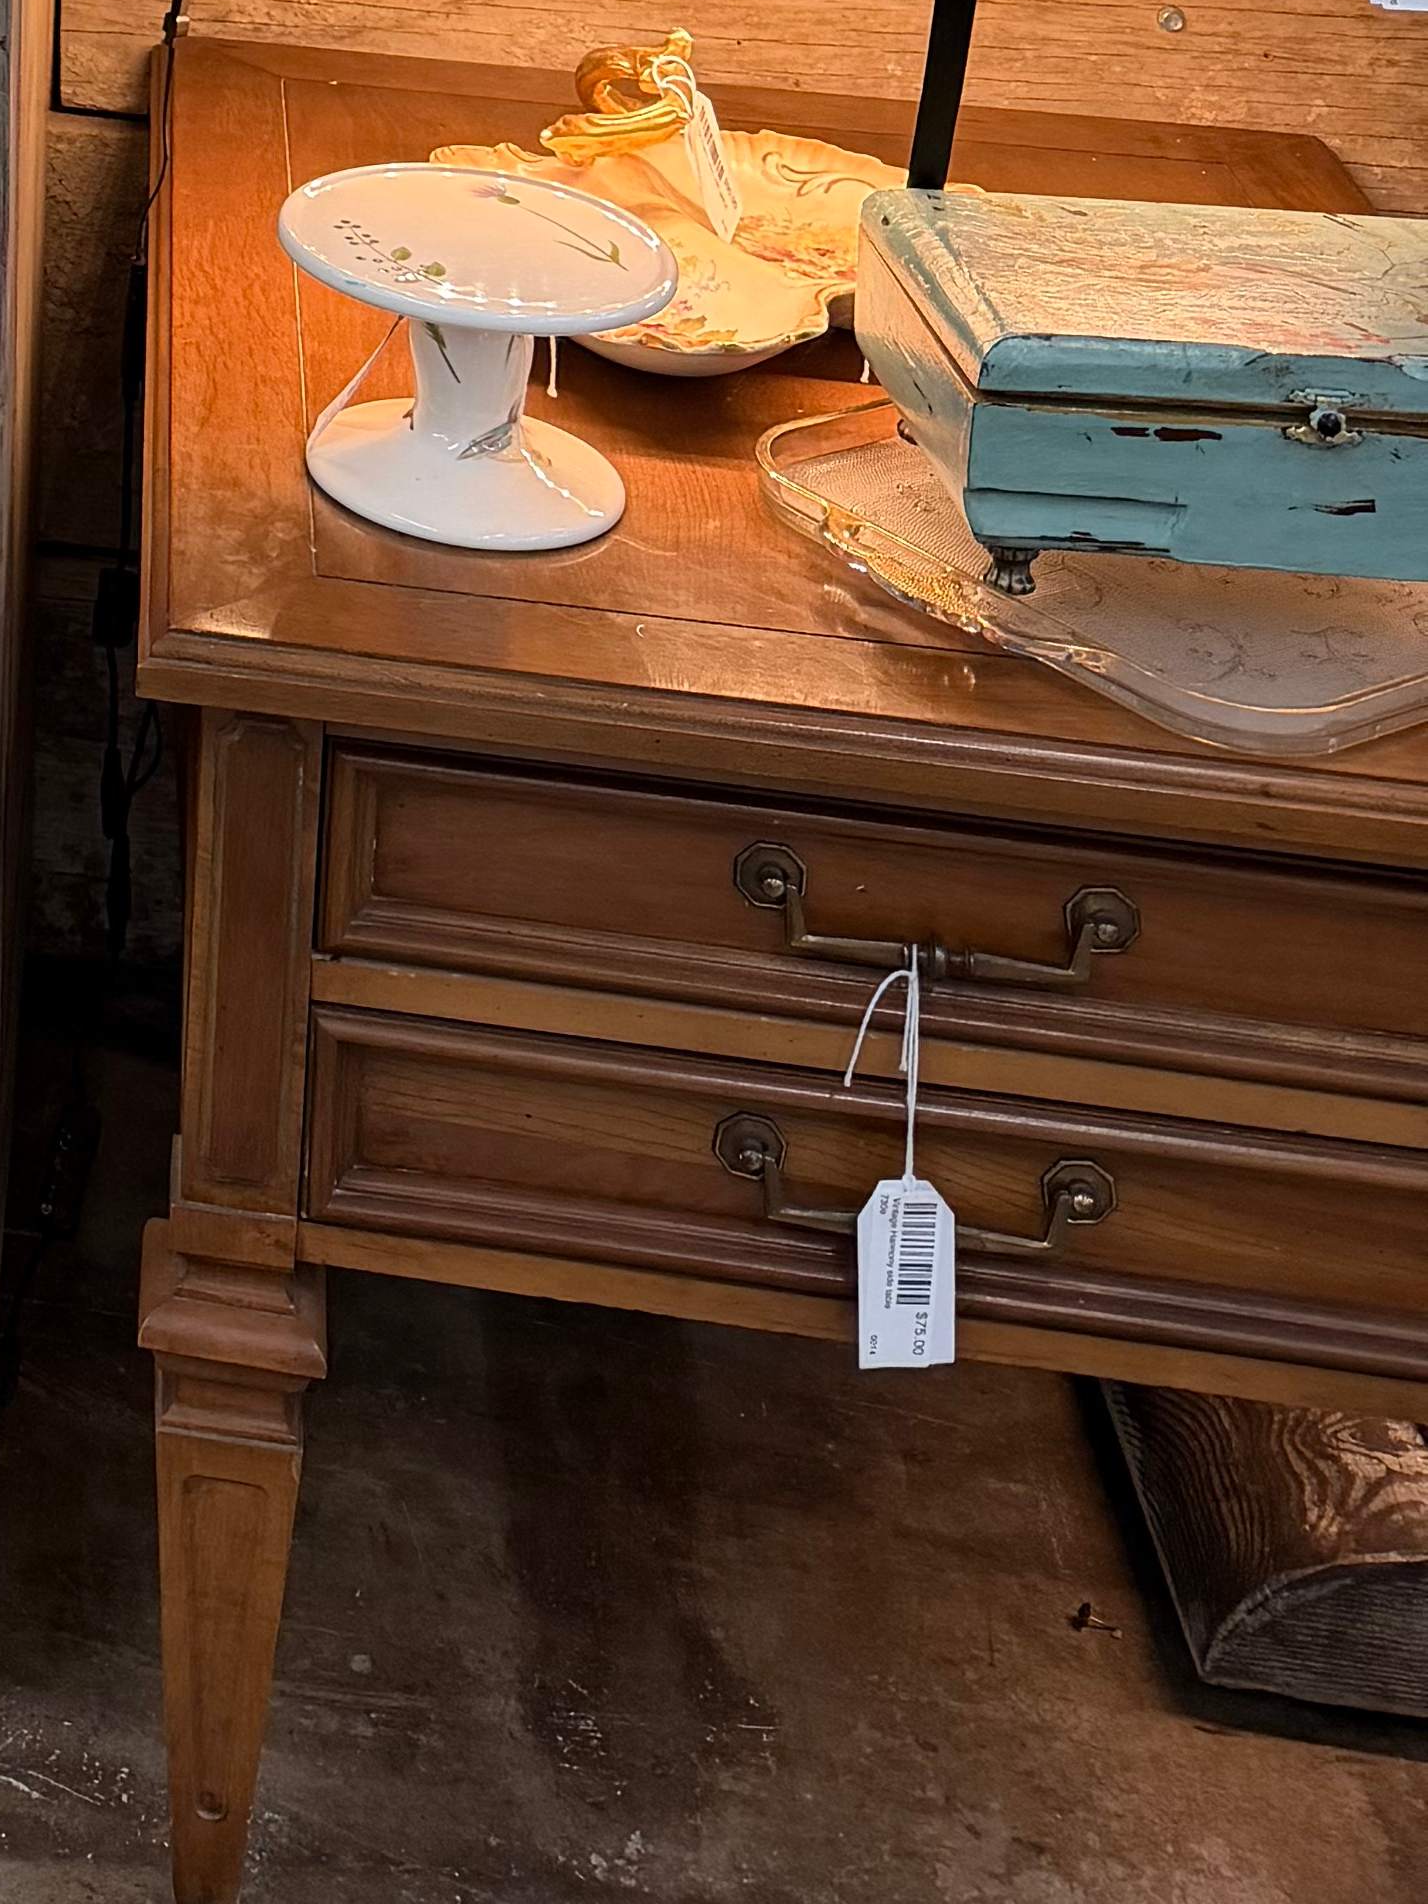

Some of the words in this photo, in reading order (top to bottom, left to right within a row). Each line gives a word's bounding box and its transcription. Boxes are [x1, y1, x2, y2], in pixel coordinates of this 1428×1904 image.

[888, 1197, 902, 1229] Vintage
[886, 1270, 895, 1287] side
[883, 1289, 894, 1309] table
[912, 1312, 928, 1357] $75.00
